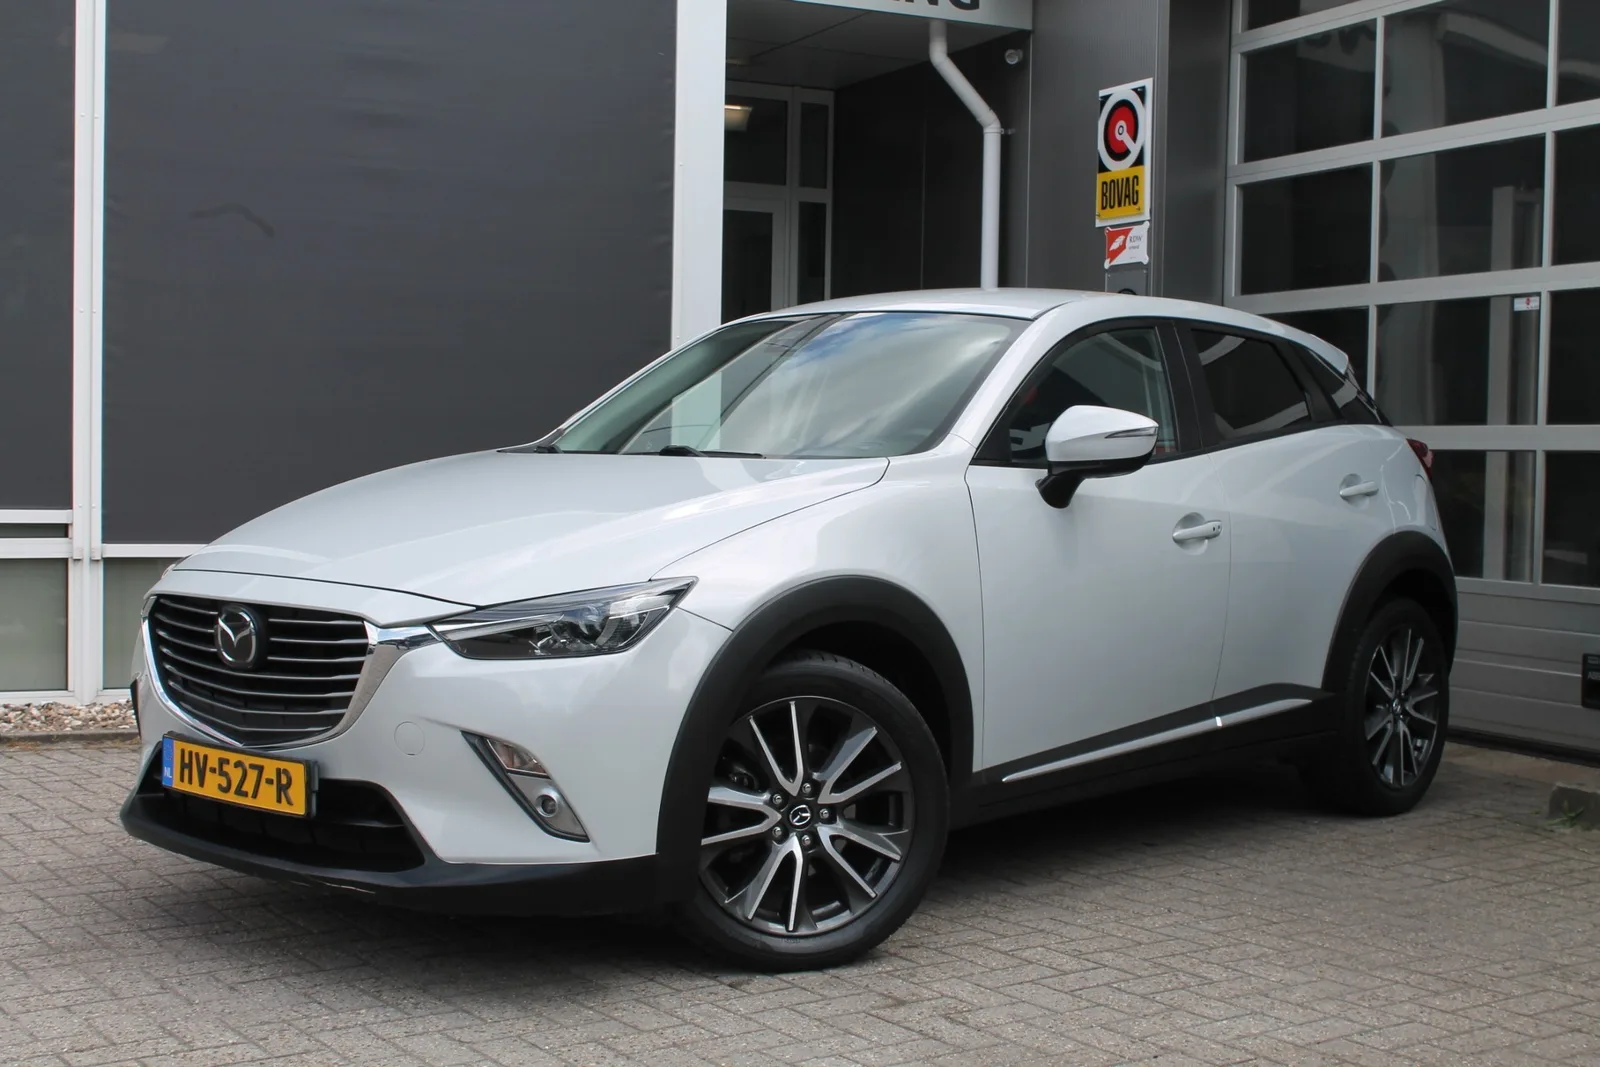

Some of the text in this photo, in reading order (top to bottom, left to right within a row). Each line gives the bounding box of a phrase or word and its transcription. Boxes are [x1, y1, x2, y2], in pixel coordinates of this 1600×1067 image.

[1101, 175, 1139, 210] BOVAG
[164, 766, 172, 779] NL
[180, 748, 294, 806] HV-527-R
